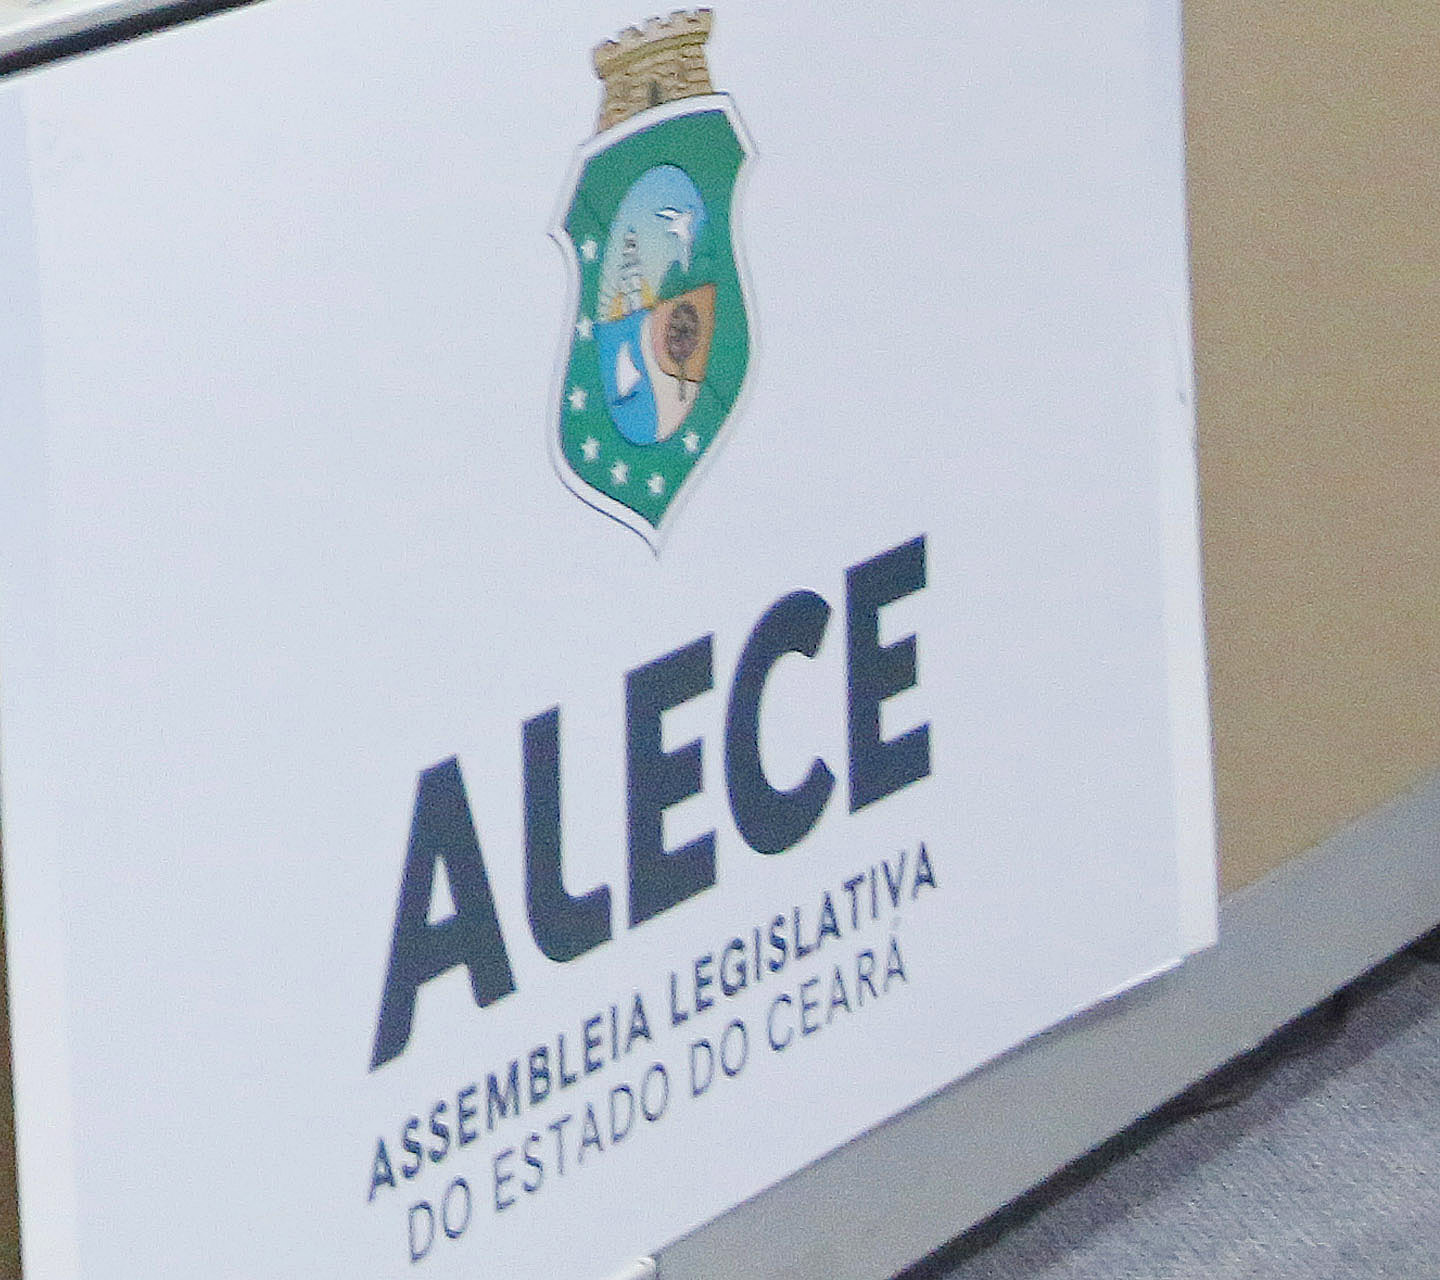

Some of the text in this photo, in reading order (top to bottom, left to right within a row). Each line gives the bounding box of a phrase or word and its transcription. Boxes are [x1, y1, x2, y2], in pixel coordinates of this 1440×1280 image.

[368, 533, 933, 1072] ALECE
[367, 841, 939, 1202] ASSEMBLEIA LEGISLATIVA
[407, 917, 908, 1264] DO ESTADO DO CEARÁ
